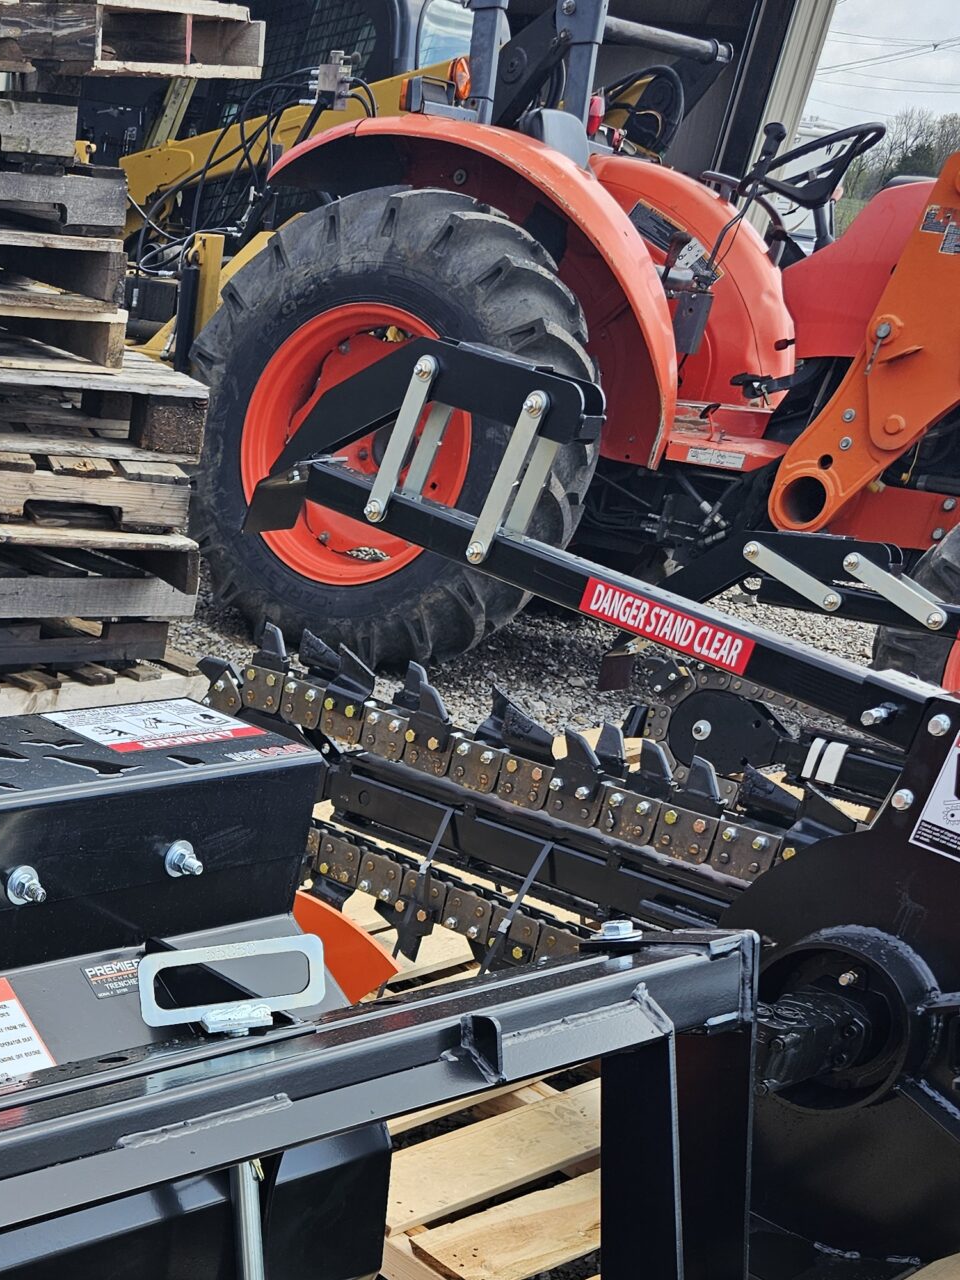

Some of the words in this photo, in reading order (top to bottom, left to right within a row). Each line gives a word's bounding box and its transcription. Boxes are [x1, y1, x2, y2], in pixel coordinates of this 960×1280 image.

[590, 584, 649, 629] DANGER
[645, 607, 696, 647] STAND
[693, 626, 743, 667] CLEAR
[104, 977, 138, 990] TRENCHE
